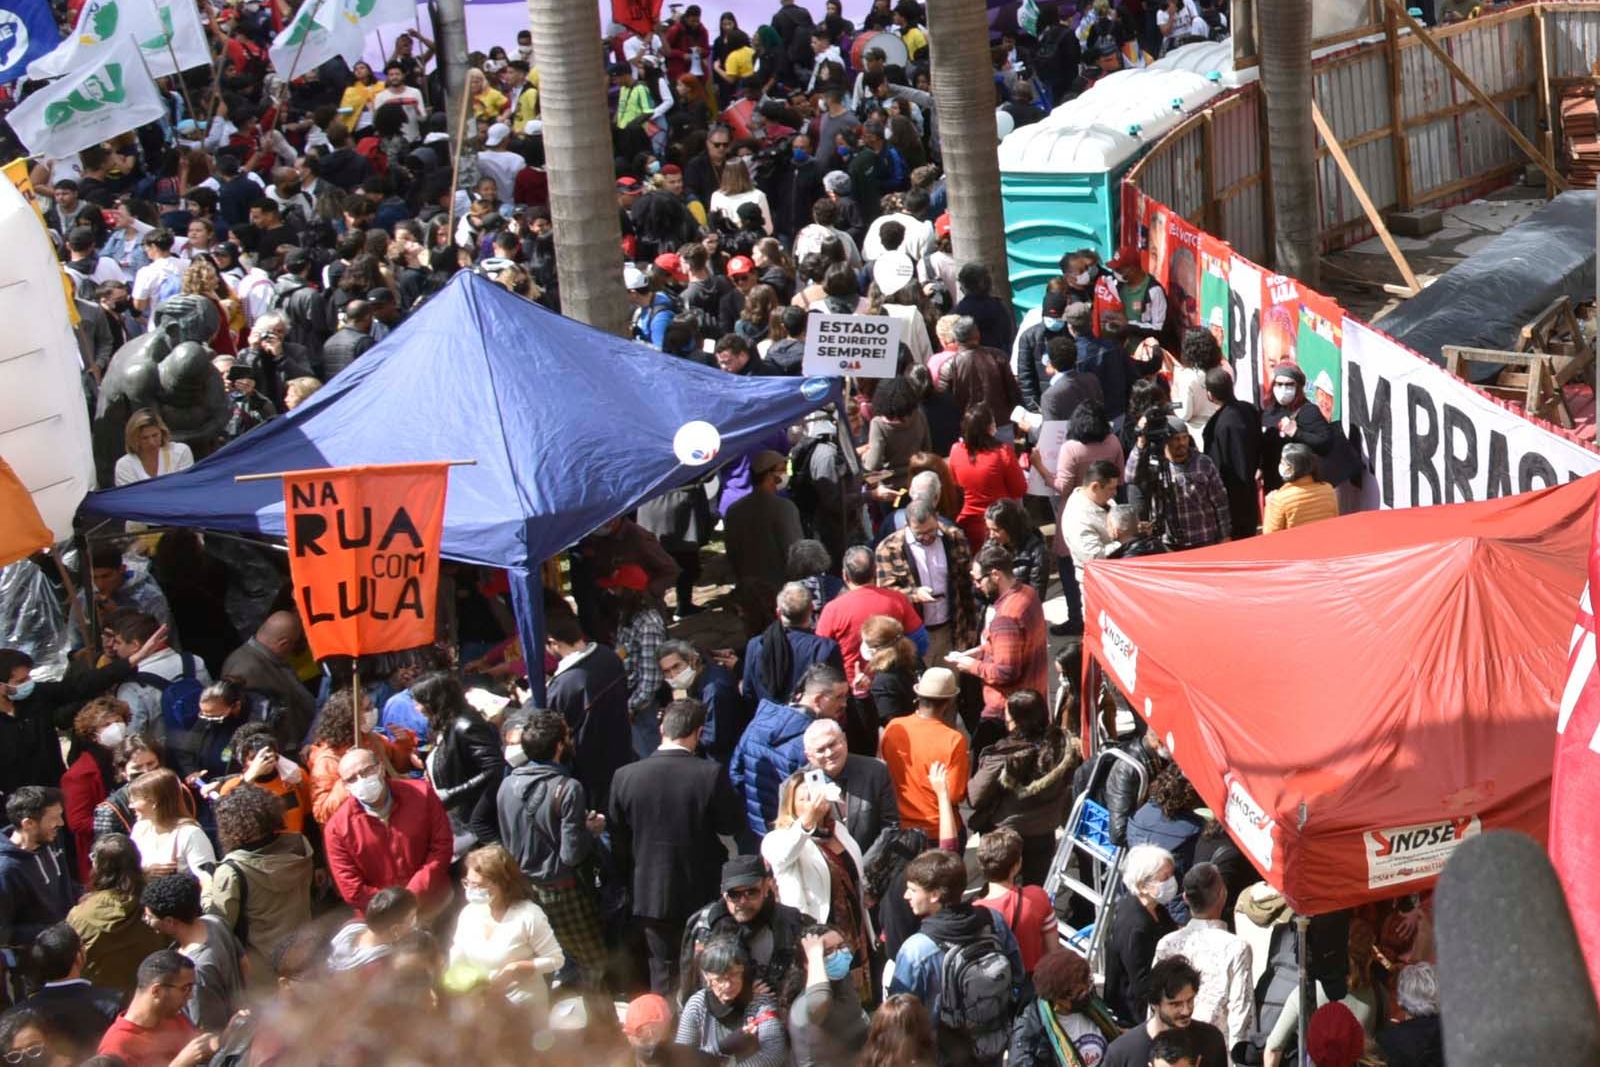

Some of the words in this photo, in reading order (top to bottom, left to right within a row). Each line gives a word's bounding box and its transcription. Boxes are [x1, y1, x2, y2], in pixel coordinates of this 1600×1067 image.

[818, 334, 836, 344] DE
[837, 336, 888, 346] DIREITO
[819, 320, 890, 335] ESTADO
[816, 346, 887, 359] SEMPRE!
[291, 481, 339, 509] NA
[294, 505, 424, 558] RUA
[371, 551, 426, 579] COM
[302, 575, 425, 627] LULA
